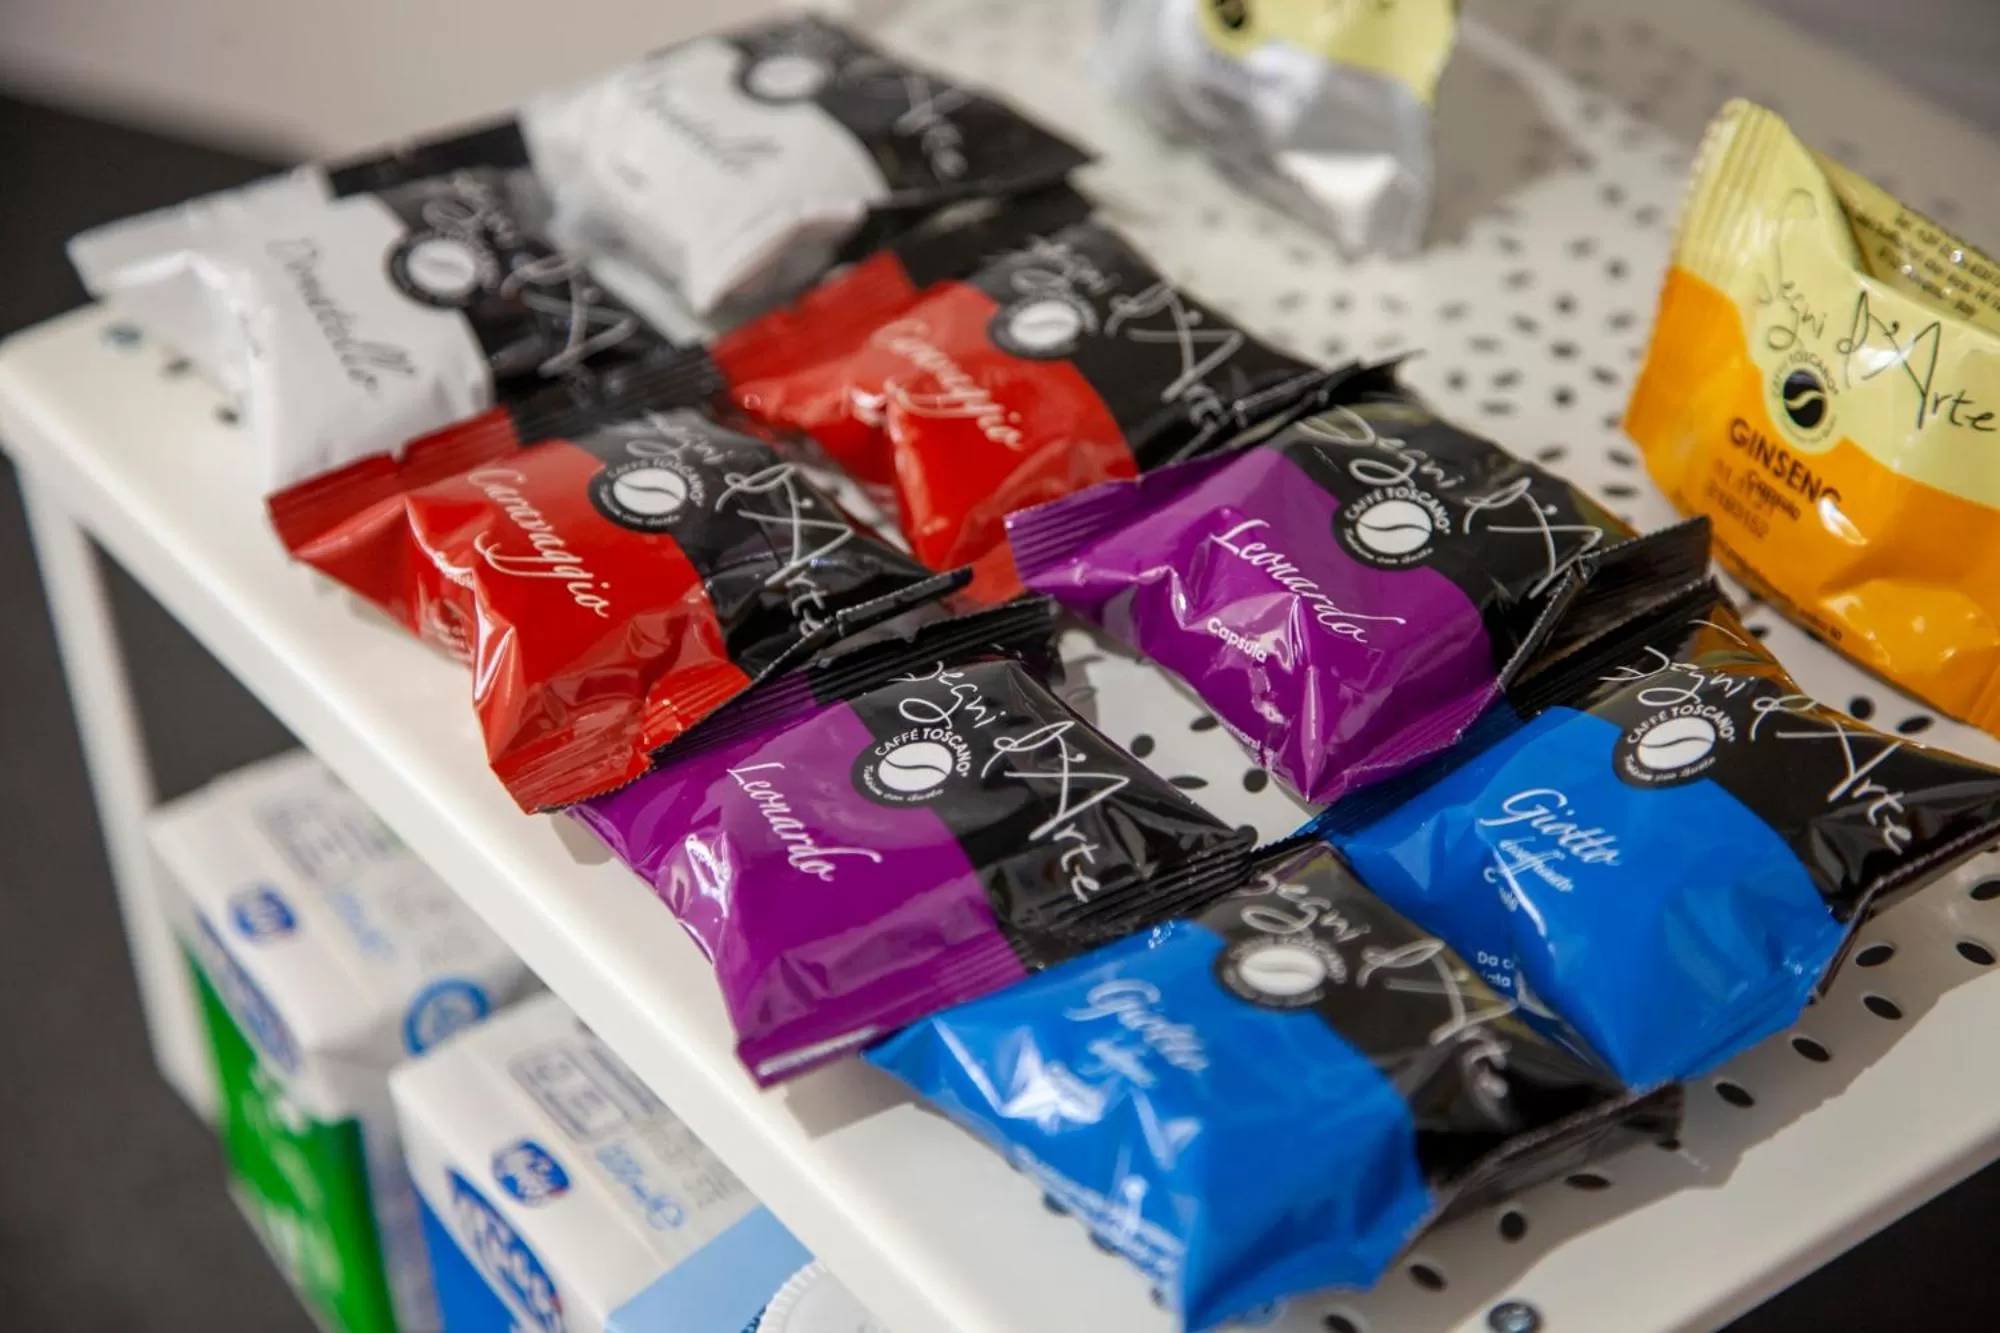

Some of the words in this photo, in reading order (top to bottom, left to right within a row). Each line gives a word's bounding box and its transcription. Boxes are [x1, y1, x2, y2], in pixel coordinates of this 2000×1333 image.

[468, 468, 611, 619] Caravaggio
[1211, 518, 1407, 644] Leonardo
[1207, 616, 1268, 663] Capsula
[727, 761, 883, 883] Leonardo
[1478, 788, 1622, 867] Giotto
